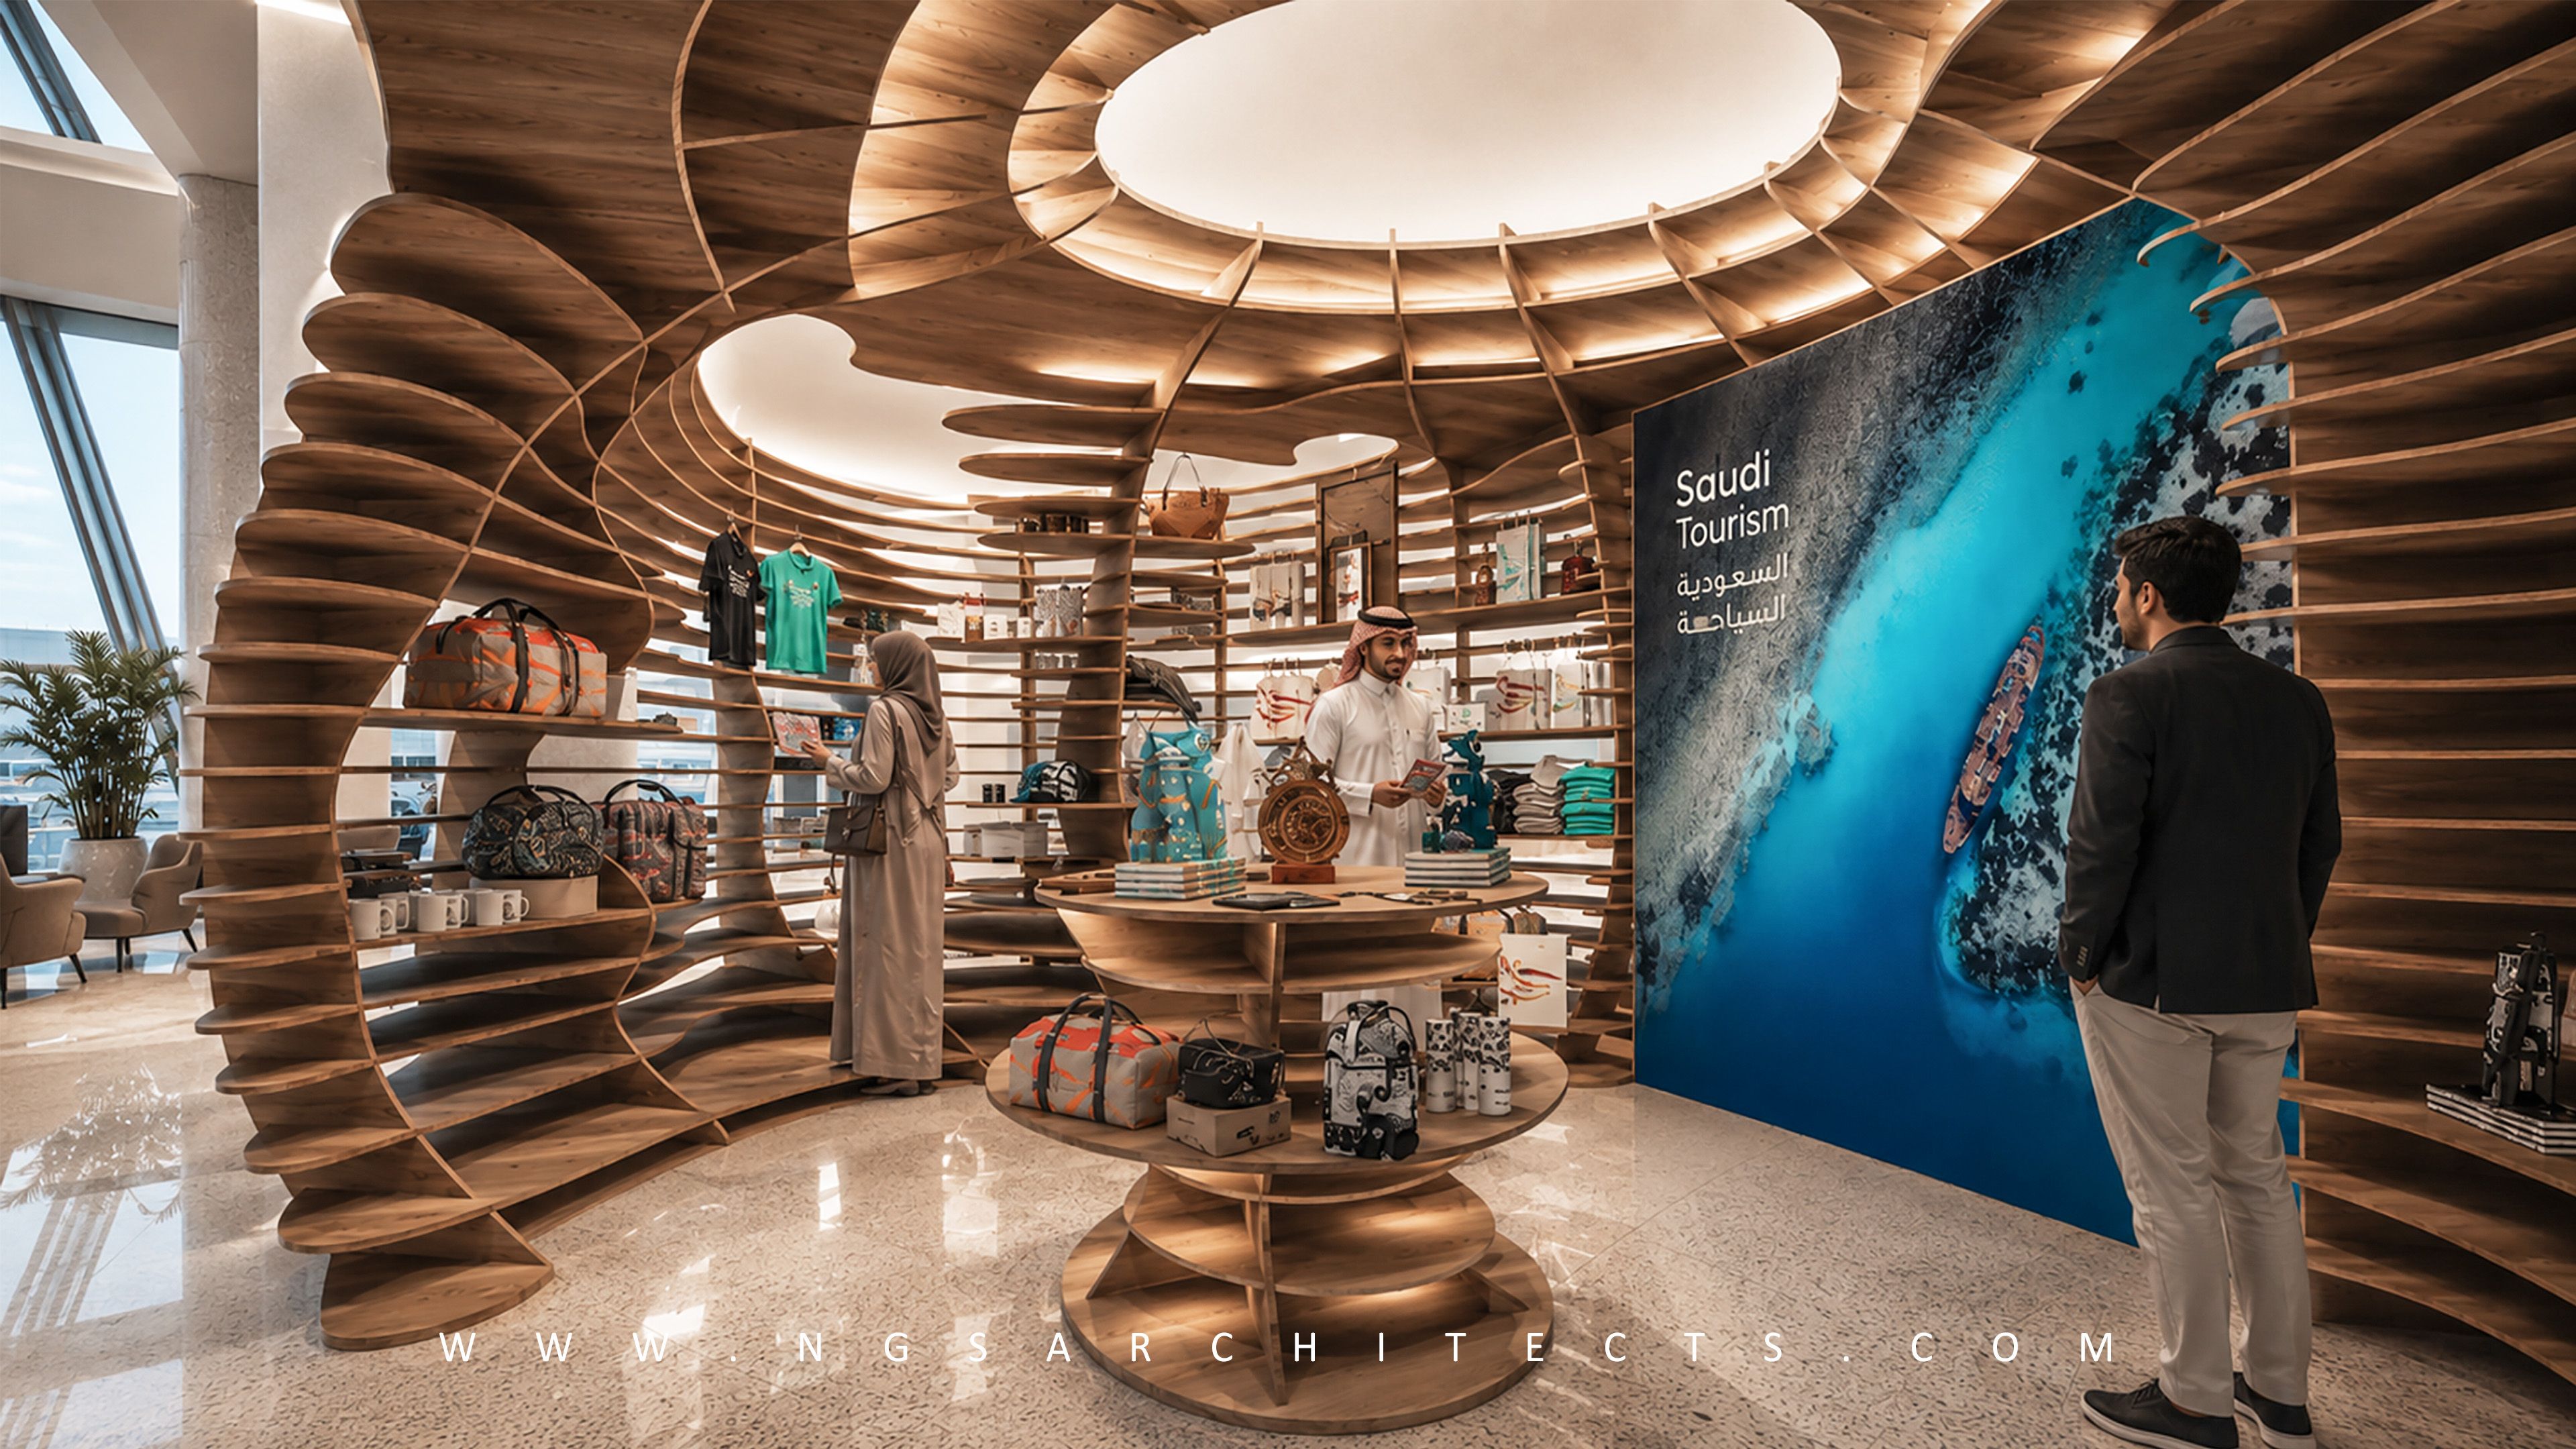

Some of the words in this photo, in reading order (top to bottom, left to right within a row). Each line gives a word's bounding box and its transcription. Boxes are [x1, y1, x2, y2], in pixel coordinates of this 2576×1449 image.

[1676, 448, 1771, 507] Saudi
[1676, 502, 1790, 549] Tourism
[1677, 553, 1789, 600] السعودية
